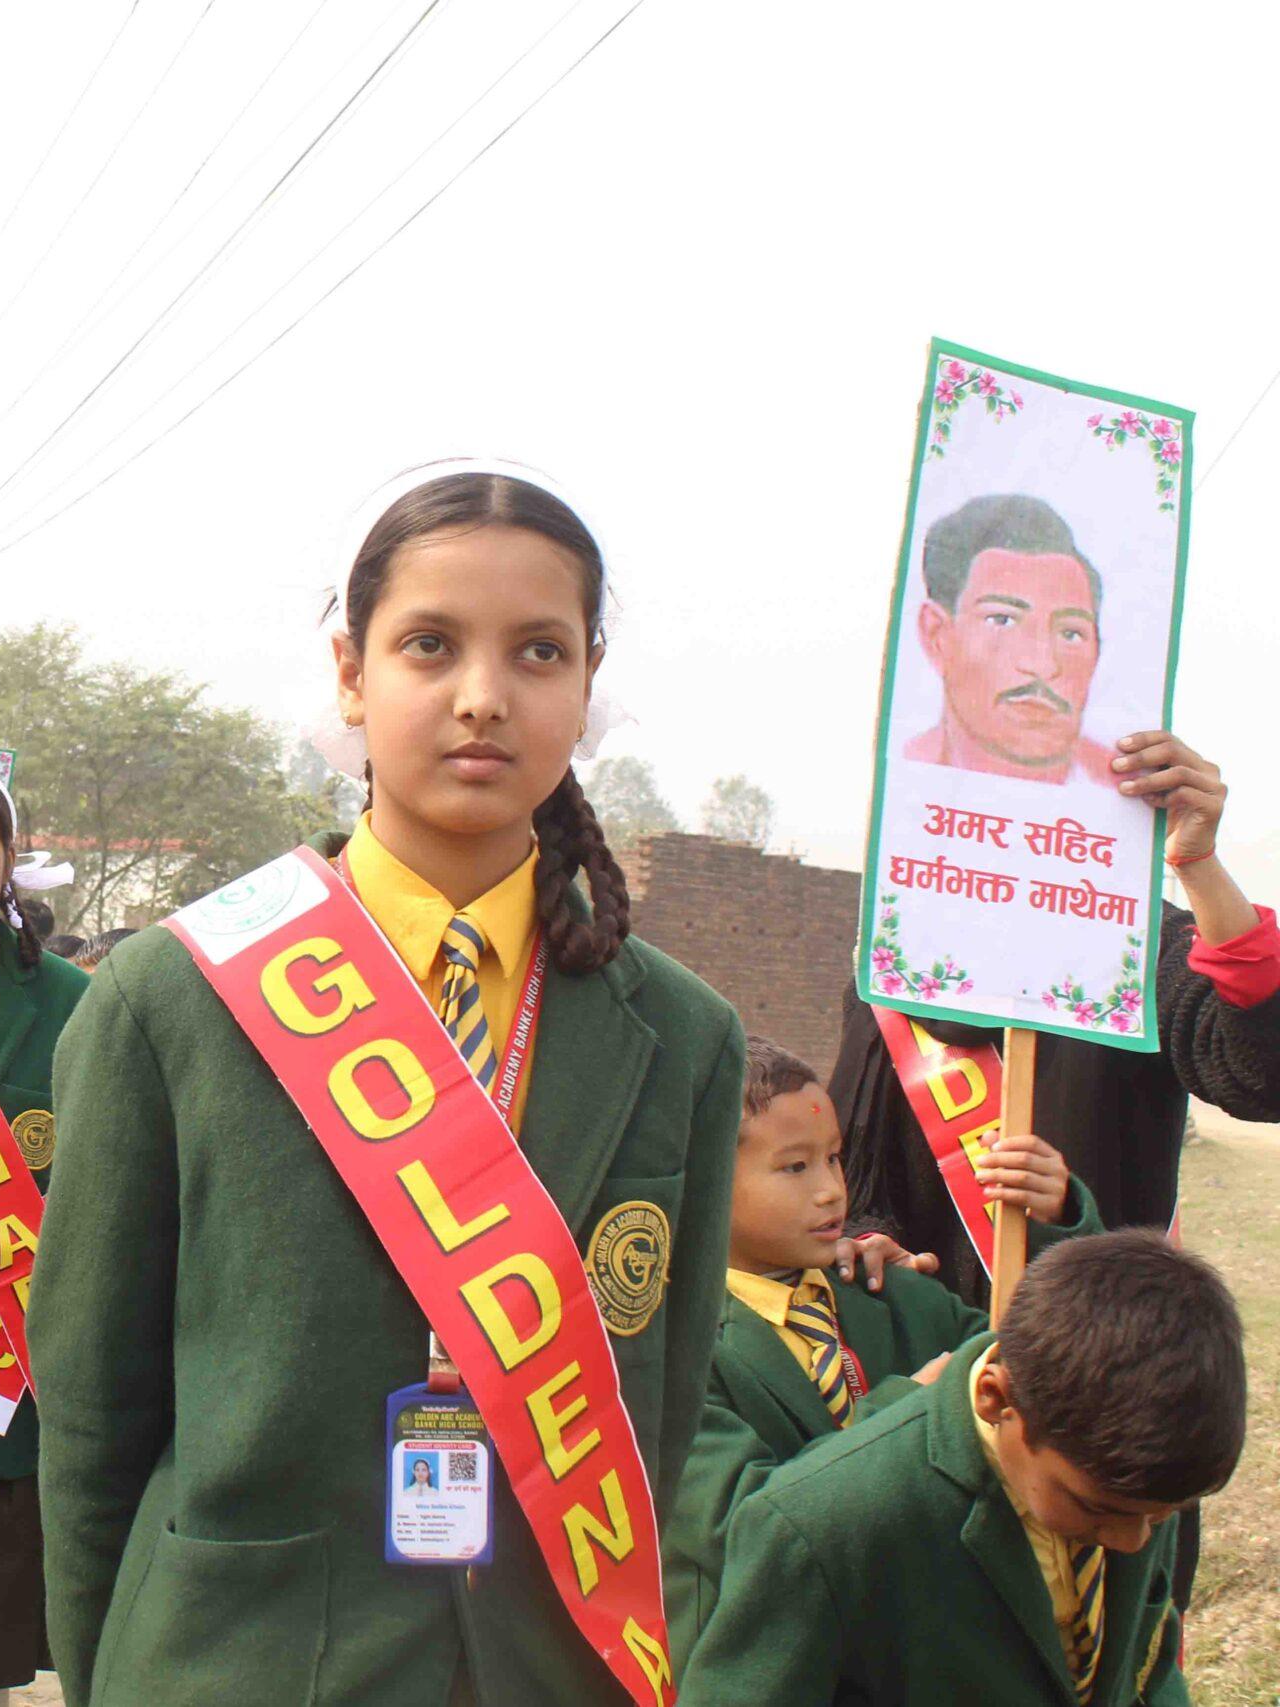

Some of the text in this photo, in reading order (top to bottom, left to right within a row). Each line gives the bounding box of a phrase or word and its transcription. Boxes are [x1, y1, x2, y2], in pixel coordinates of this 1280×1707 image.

[923, 803, 1117, 868] अमर सहिद
[889, 855, 1139, 926] धर्मभक्त माथेमा
[497, 1050, 523, 1110] ACADEMY
[514, 1006, 535, 1050] BANKE
[525, 974, 541, 1008] HIGH
[259, 936, 635, 1598] GOLDEN
